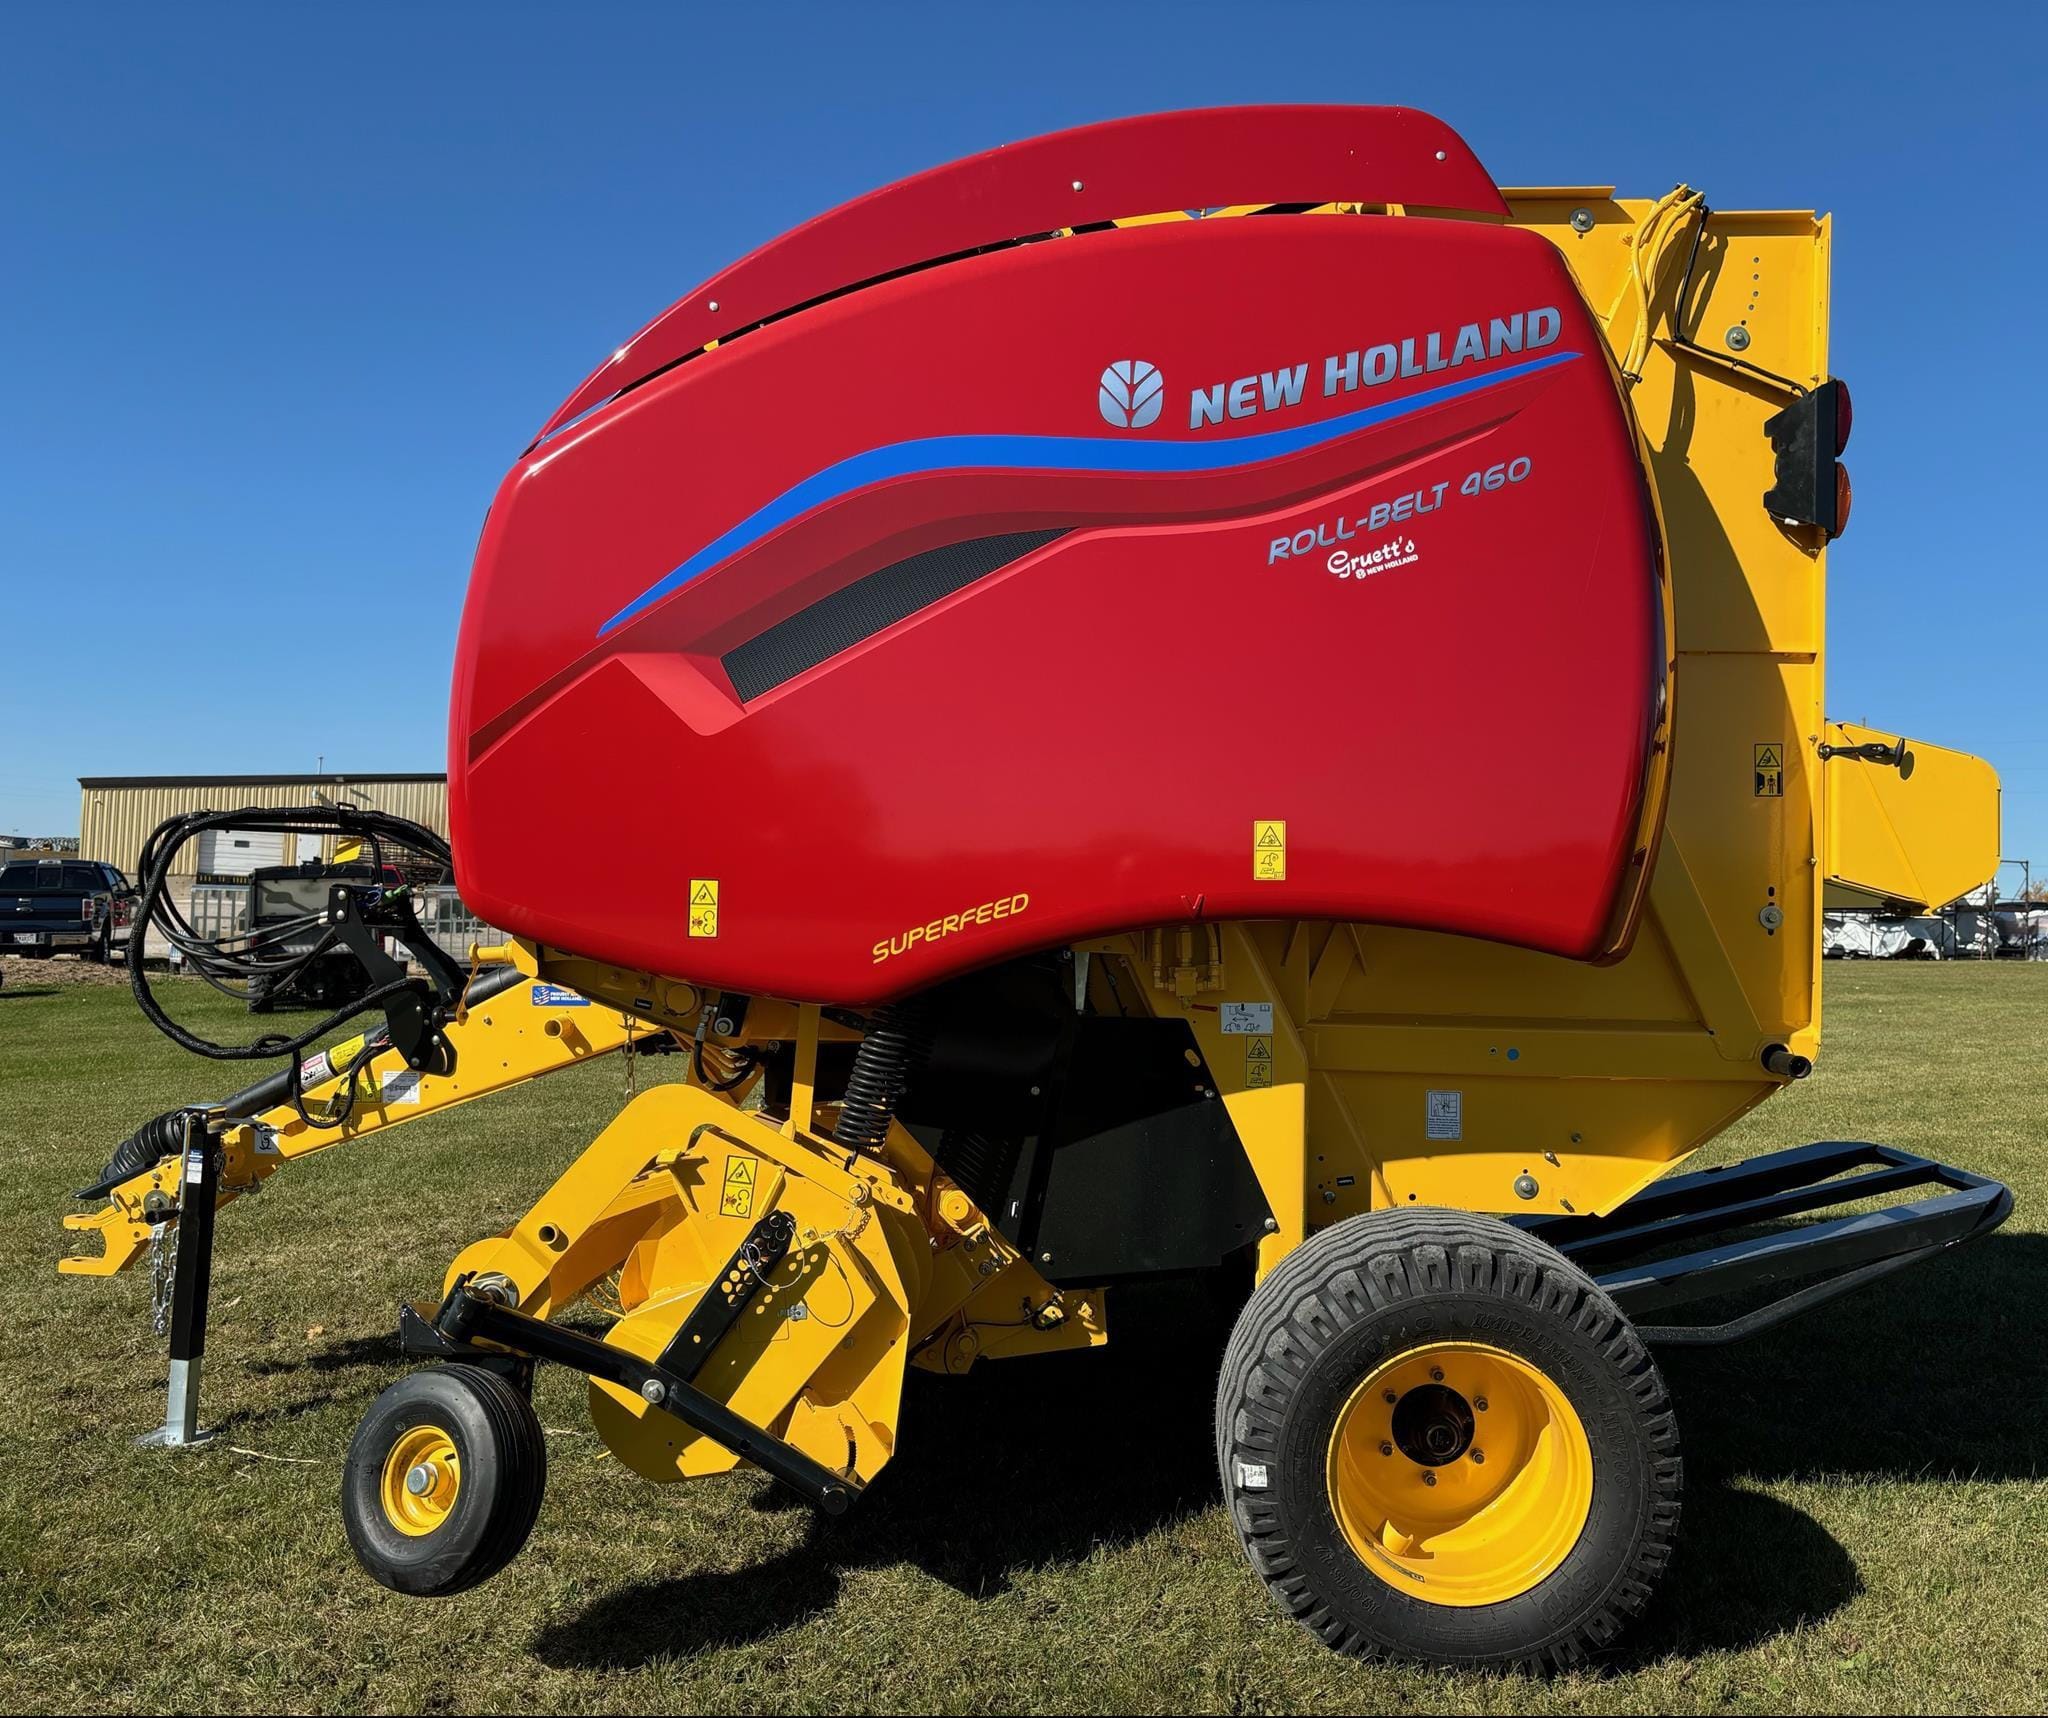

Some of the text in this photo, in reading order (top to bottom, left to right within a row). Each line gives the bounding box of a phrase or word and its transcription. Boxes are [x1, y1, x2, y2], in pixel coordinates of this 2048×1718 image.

[1189, 305, 1563, 430] NEW HOLLAND
[1267, 456, 1533, 566] ROLL-BELT 460
[1326, 535, 1416, 579] Gruett's
[1366, 553, 1419, 576] NEW HOLLAND
[872, 892, 1030, 965] SUPERFEED
